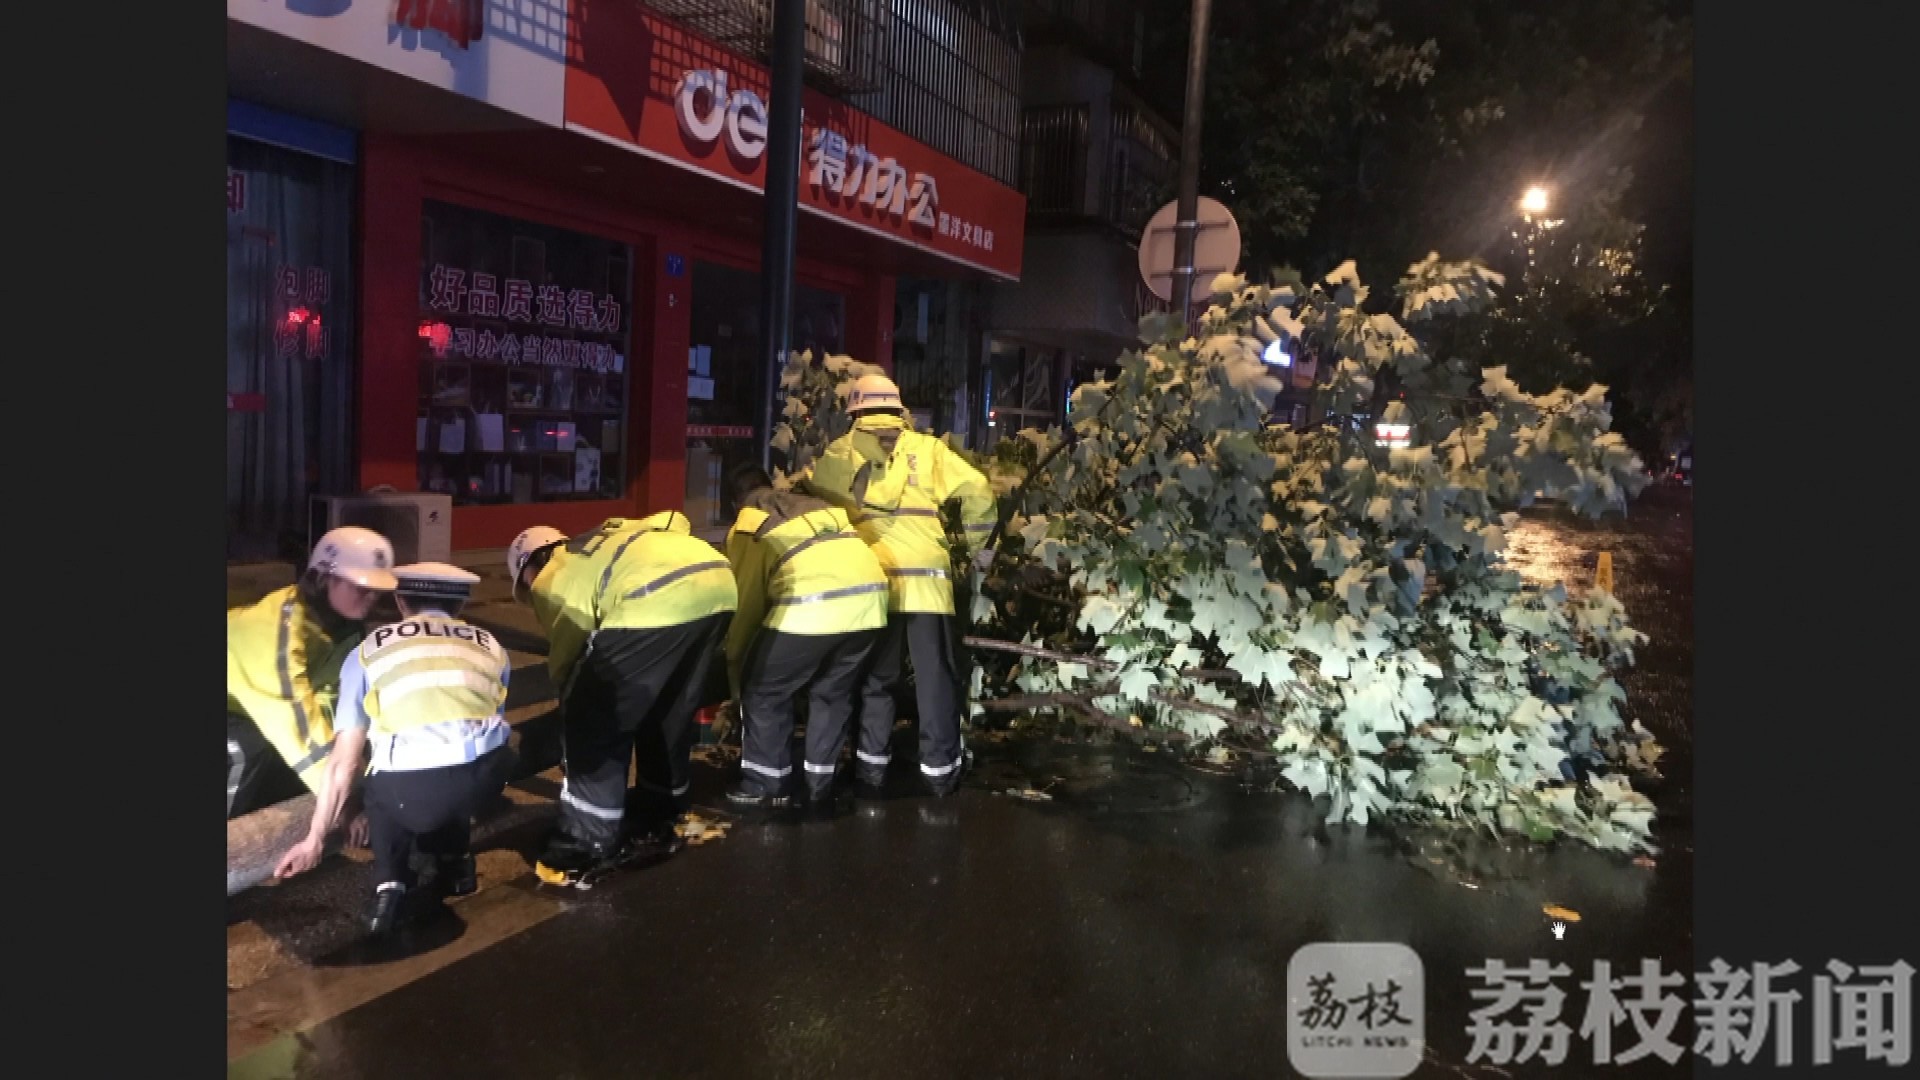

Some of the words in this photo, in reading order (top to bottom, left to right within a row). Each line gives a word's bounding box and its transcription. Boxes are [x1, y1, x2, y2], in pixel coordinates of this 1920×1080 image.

[808, 127, 939, 228] 得力办公
[275, 263, 331, 303] 泡脚
[430, 264, 621, 333] 好品质选得力
[375, 621, 491, 651] POLICE
